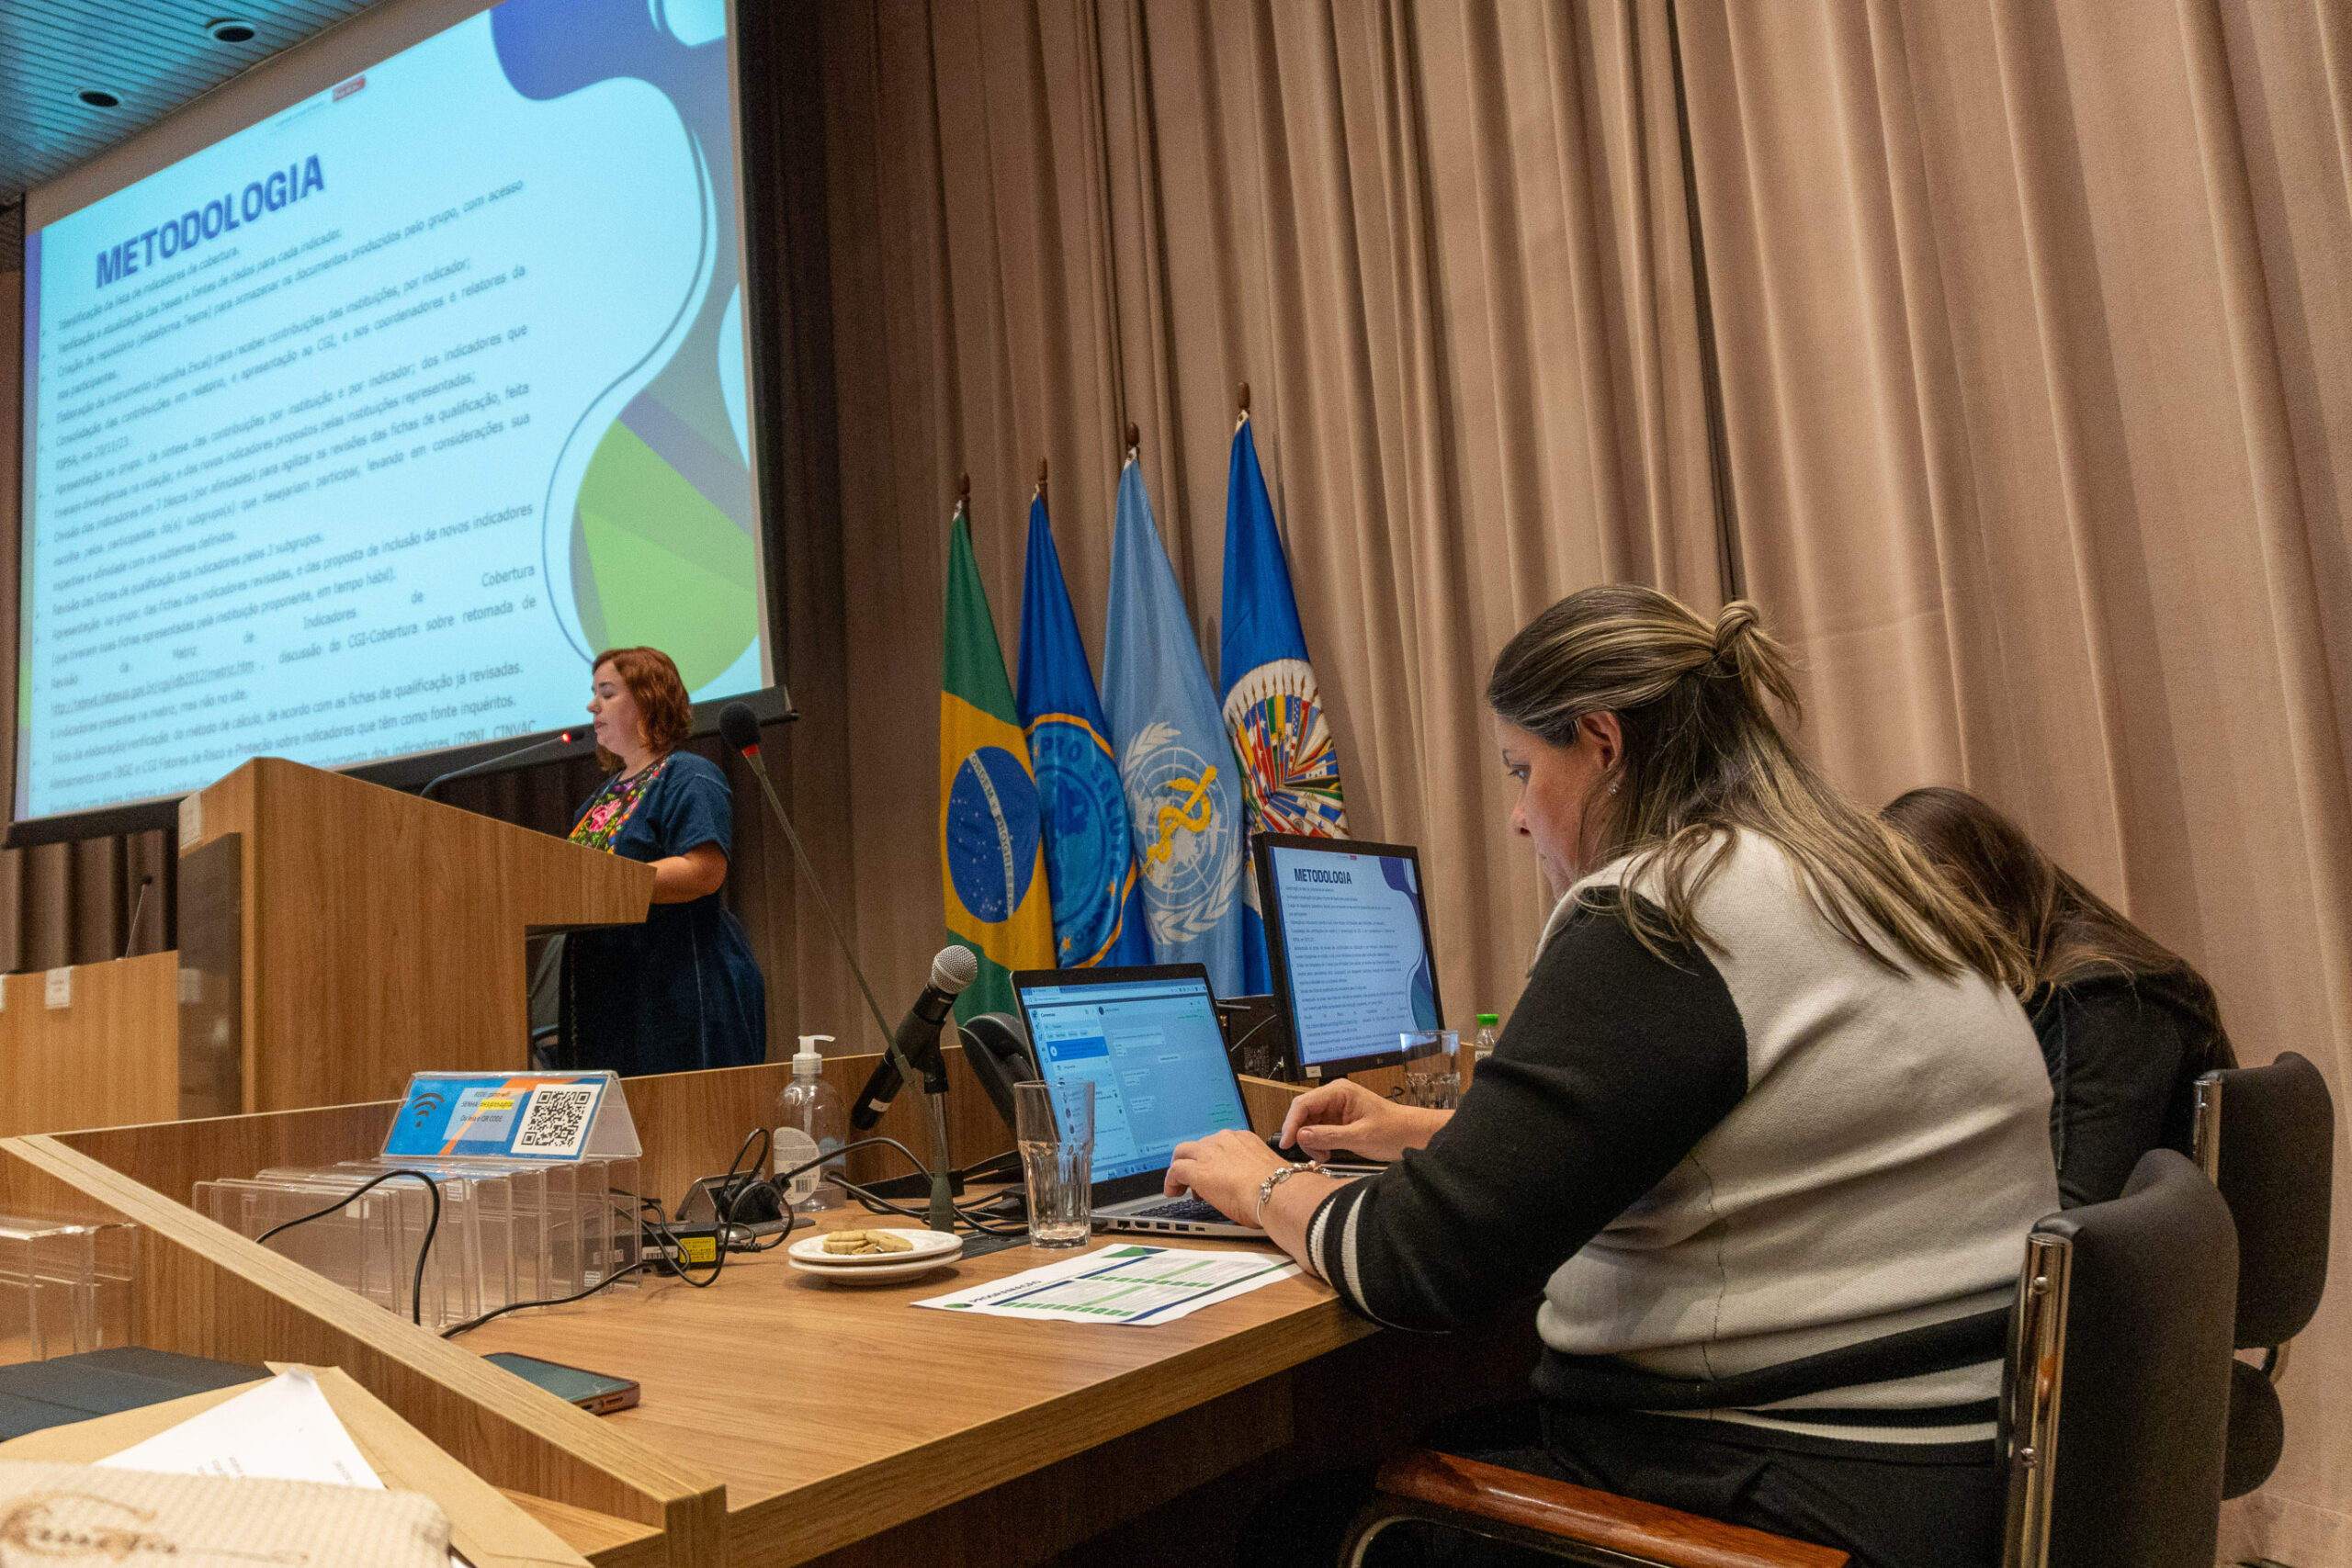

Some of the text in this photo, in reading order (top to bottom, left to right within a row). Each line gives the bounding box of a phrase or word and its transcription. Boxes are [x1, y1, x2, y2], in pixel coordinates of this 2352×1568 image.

[96, 153, 324, 289] METODOLOGIA
[473, 503, 532, 528] indicadores
[481, 565, 534, 587] Cobertura
[462, 600, 513, 622] retomada
[469, 661, 522, 682] revisadas.
[460, 695, 515, 716] inquéritos.
[971, 755, 994, 799] ORDEM
[1294, 868, 1352, 885] METODOLOGIA
